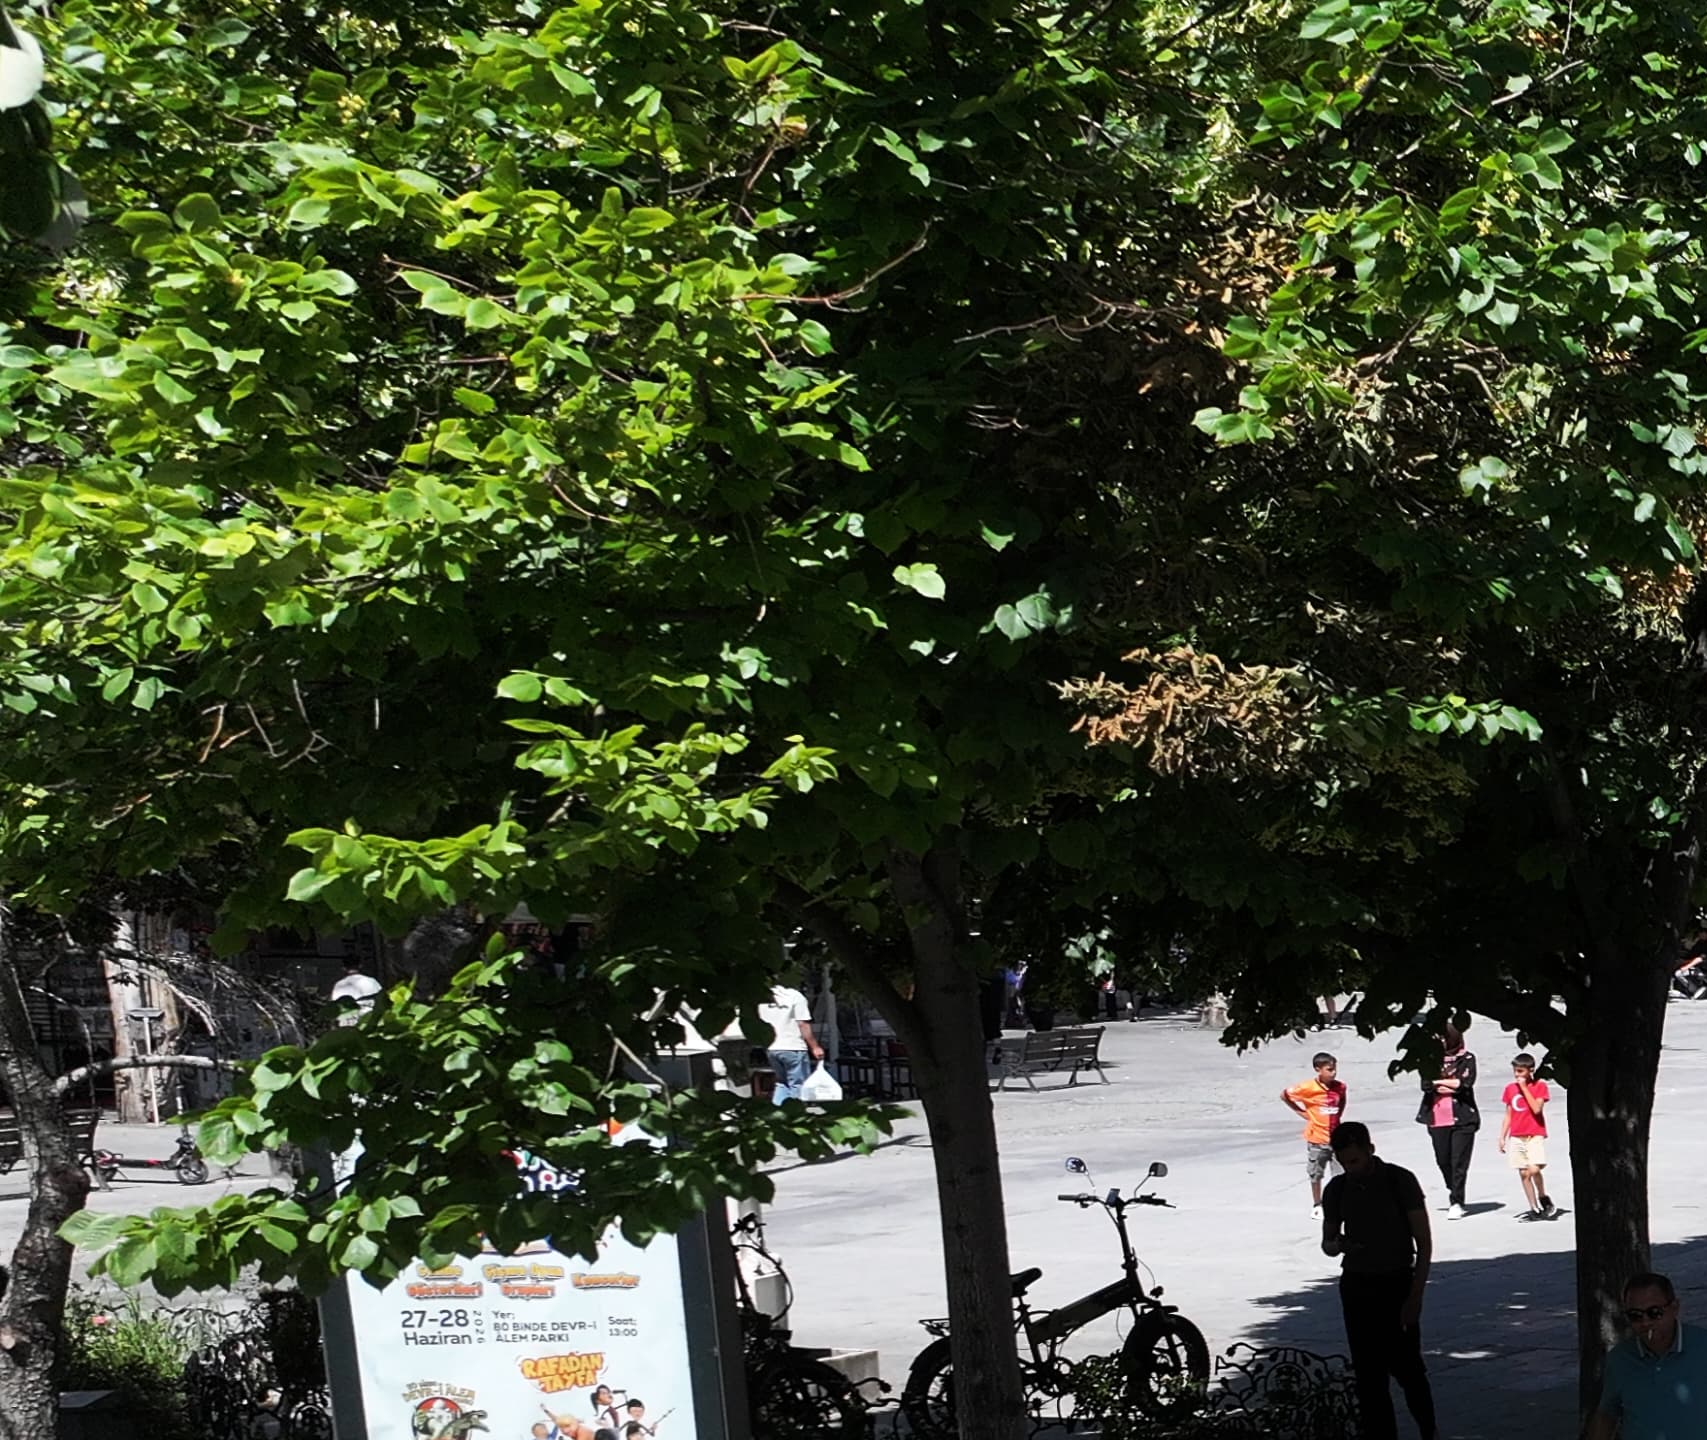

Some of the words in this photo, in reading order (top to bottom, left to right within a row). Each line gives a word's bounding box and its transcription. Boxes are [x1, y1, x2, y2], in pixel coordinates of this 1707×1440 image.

[400, 1308, 470, 1329] 27-28
[403, 1331, 473, 1346] Haziran
[521, 1352, 604, 1379] RAFADAN
[539, 1371, 597, 1394] TAYFA
